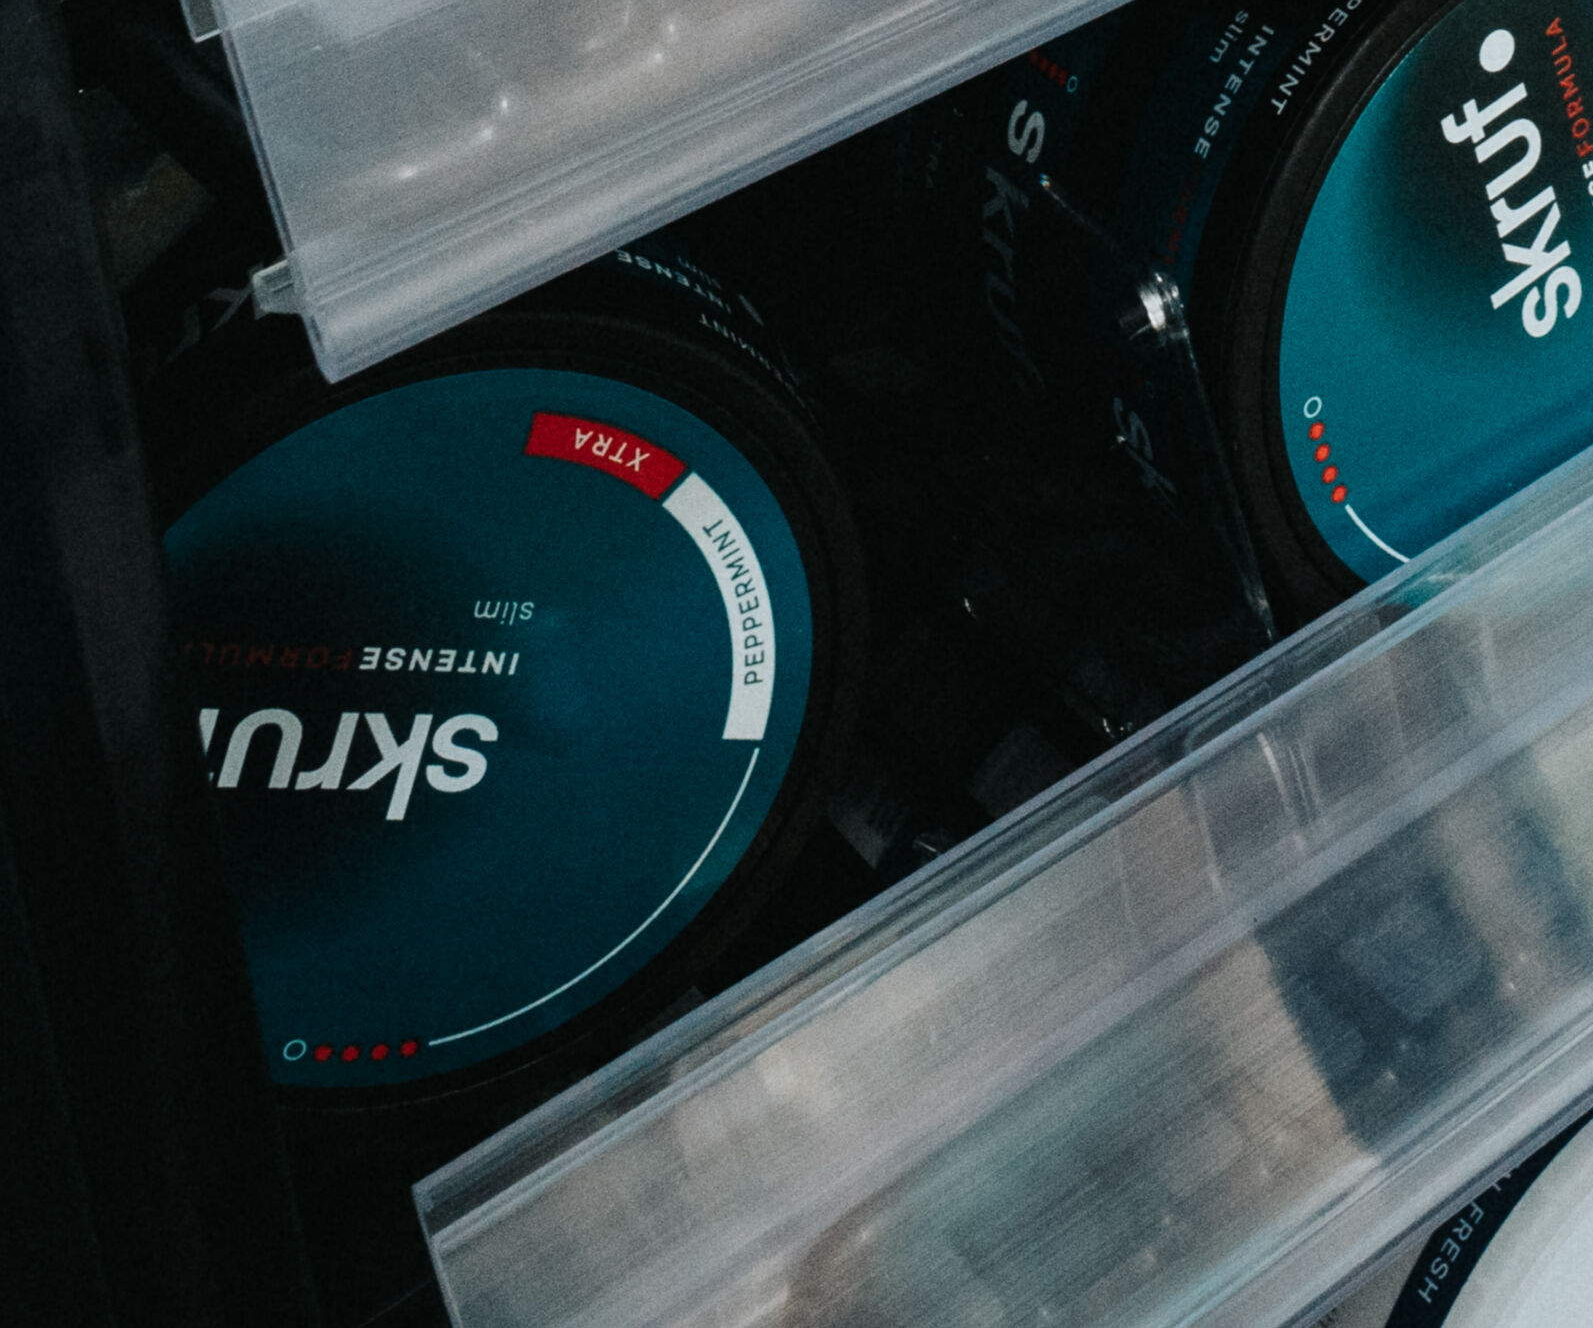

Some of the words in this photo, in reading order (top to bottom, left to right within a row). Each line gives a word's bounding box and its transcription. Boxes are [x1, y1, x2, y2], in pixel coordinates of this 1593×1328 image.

[1209, 9, 1250, 65] slim
[1194, 23, 1276, 159] INTENSE
[573, 426, 652, 471] XTRA
[473, 599, 536, 625] slim
[702, 518, 765, 687] PEPPERMINT
[1420, 1200, 1485, 1304] FRESH
